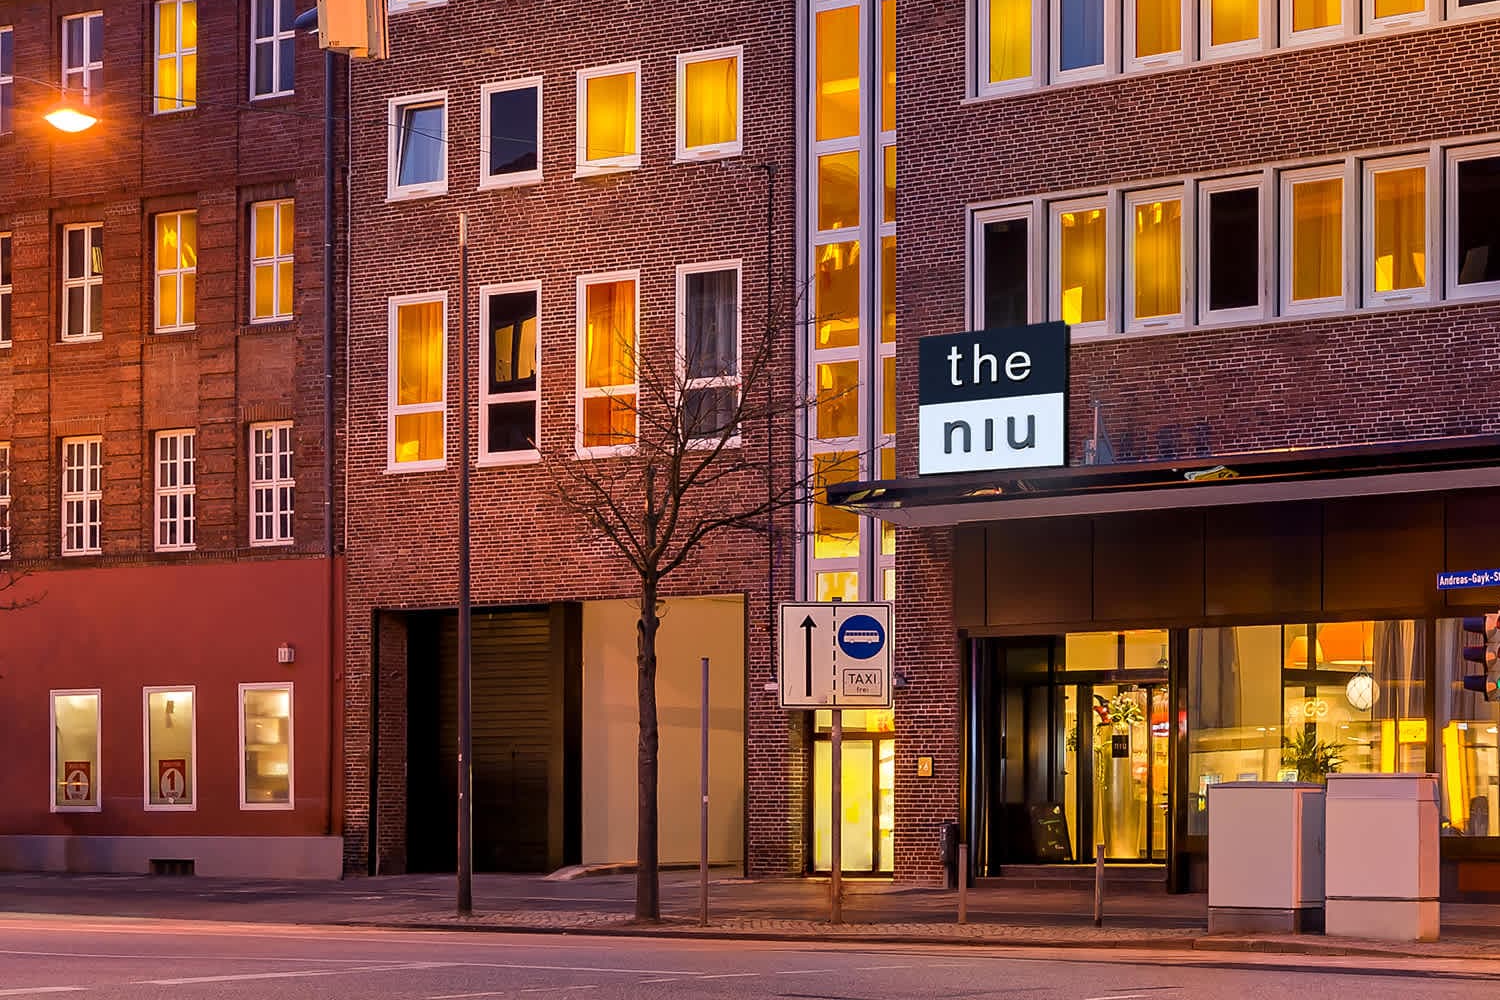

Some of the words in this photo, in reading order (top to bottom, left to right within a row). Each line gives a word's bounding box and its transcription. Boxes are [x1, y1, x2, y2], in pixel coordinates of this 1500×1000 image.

[947, 343, 1032, 386] the
[943, 414, 1036, 455] niu
[848, 673, 877, 684] TAXI
[856, 686, 870, 694] frei
[166, 770, 176, 791] 1
